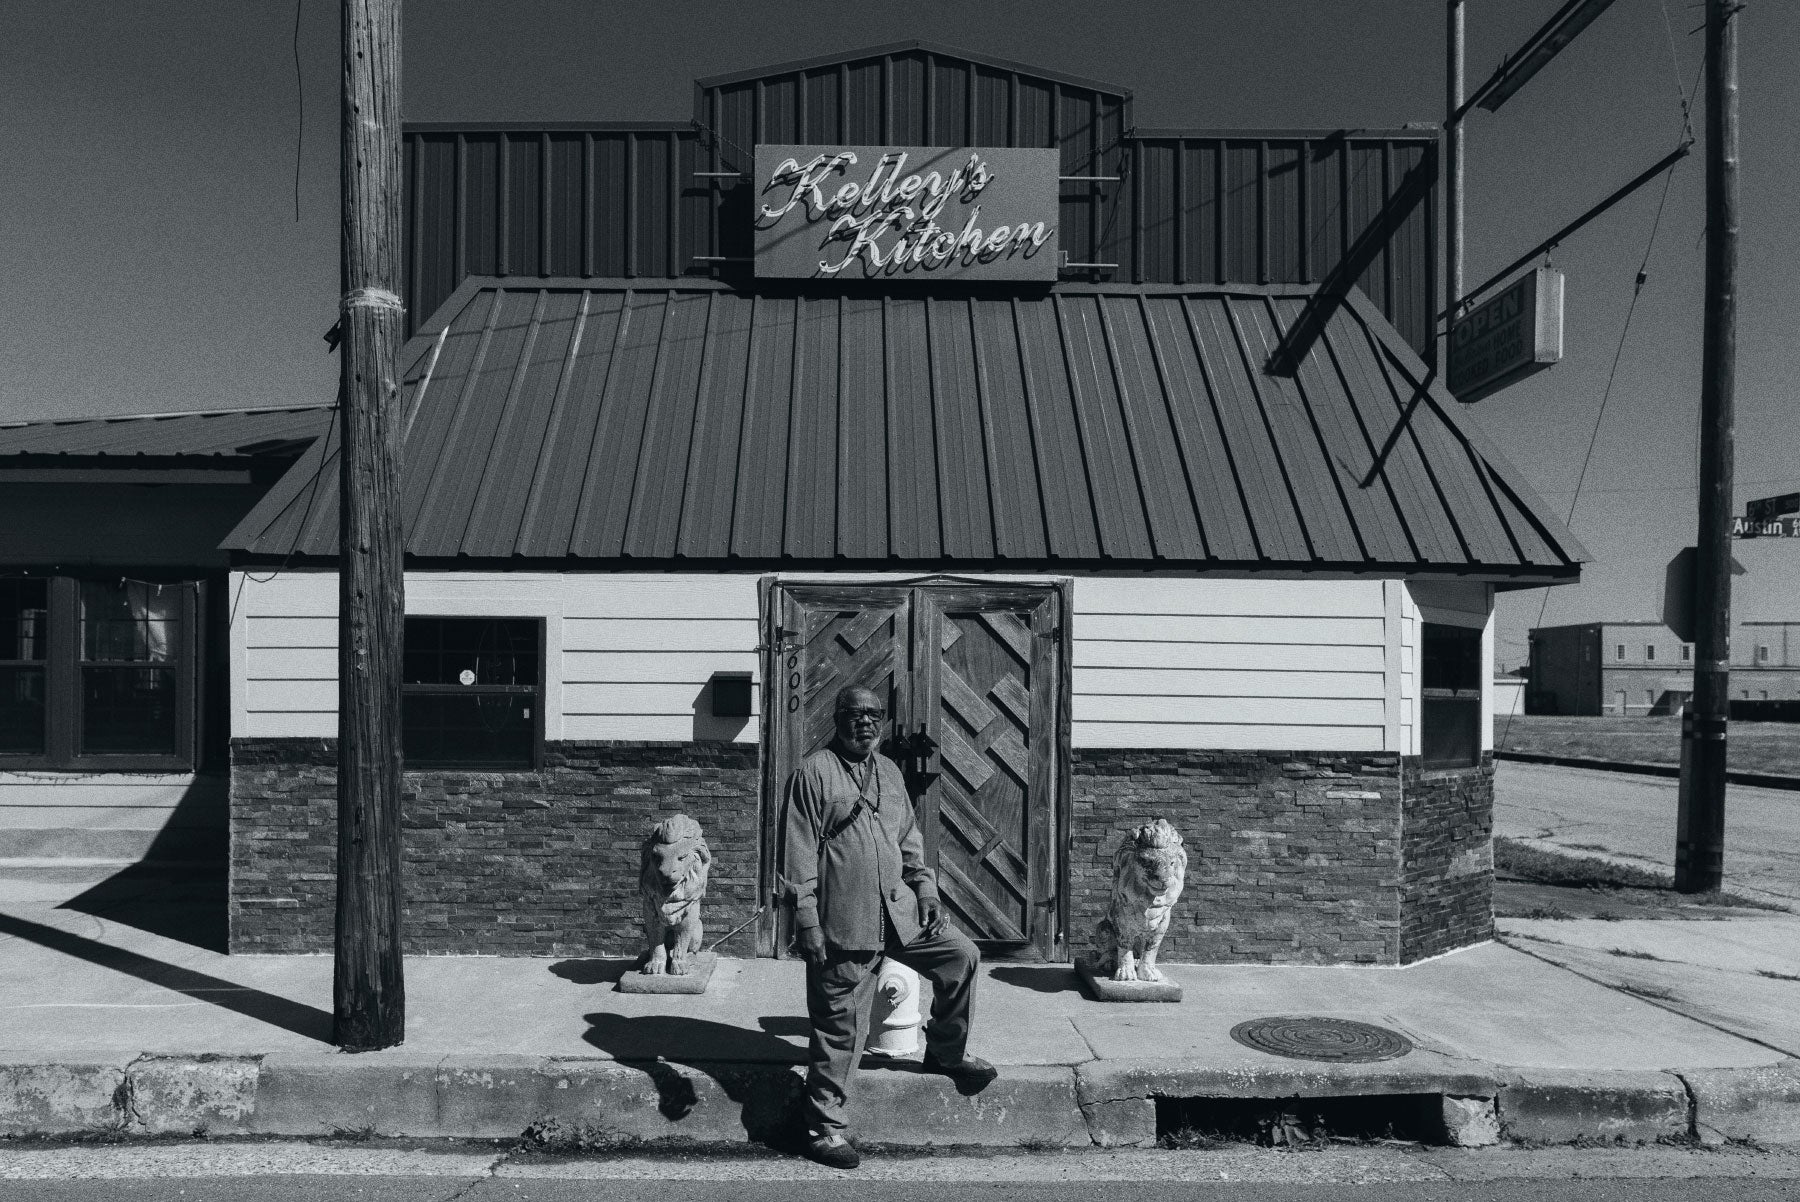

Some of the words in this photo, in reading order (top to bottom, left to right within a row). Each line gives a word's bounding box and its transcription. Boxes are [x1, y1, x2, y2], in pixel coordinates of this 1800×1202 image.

[761, 152, 994, 224] Kelley's
[819, 205, 1054, 273] Kitchen
[1456, 289, 1519, 347] OPEN
[1733, 517, 1783, 535] Austin
[787, 649, 800, 714] 600
